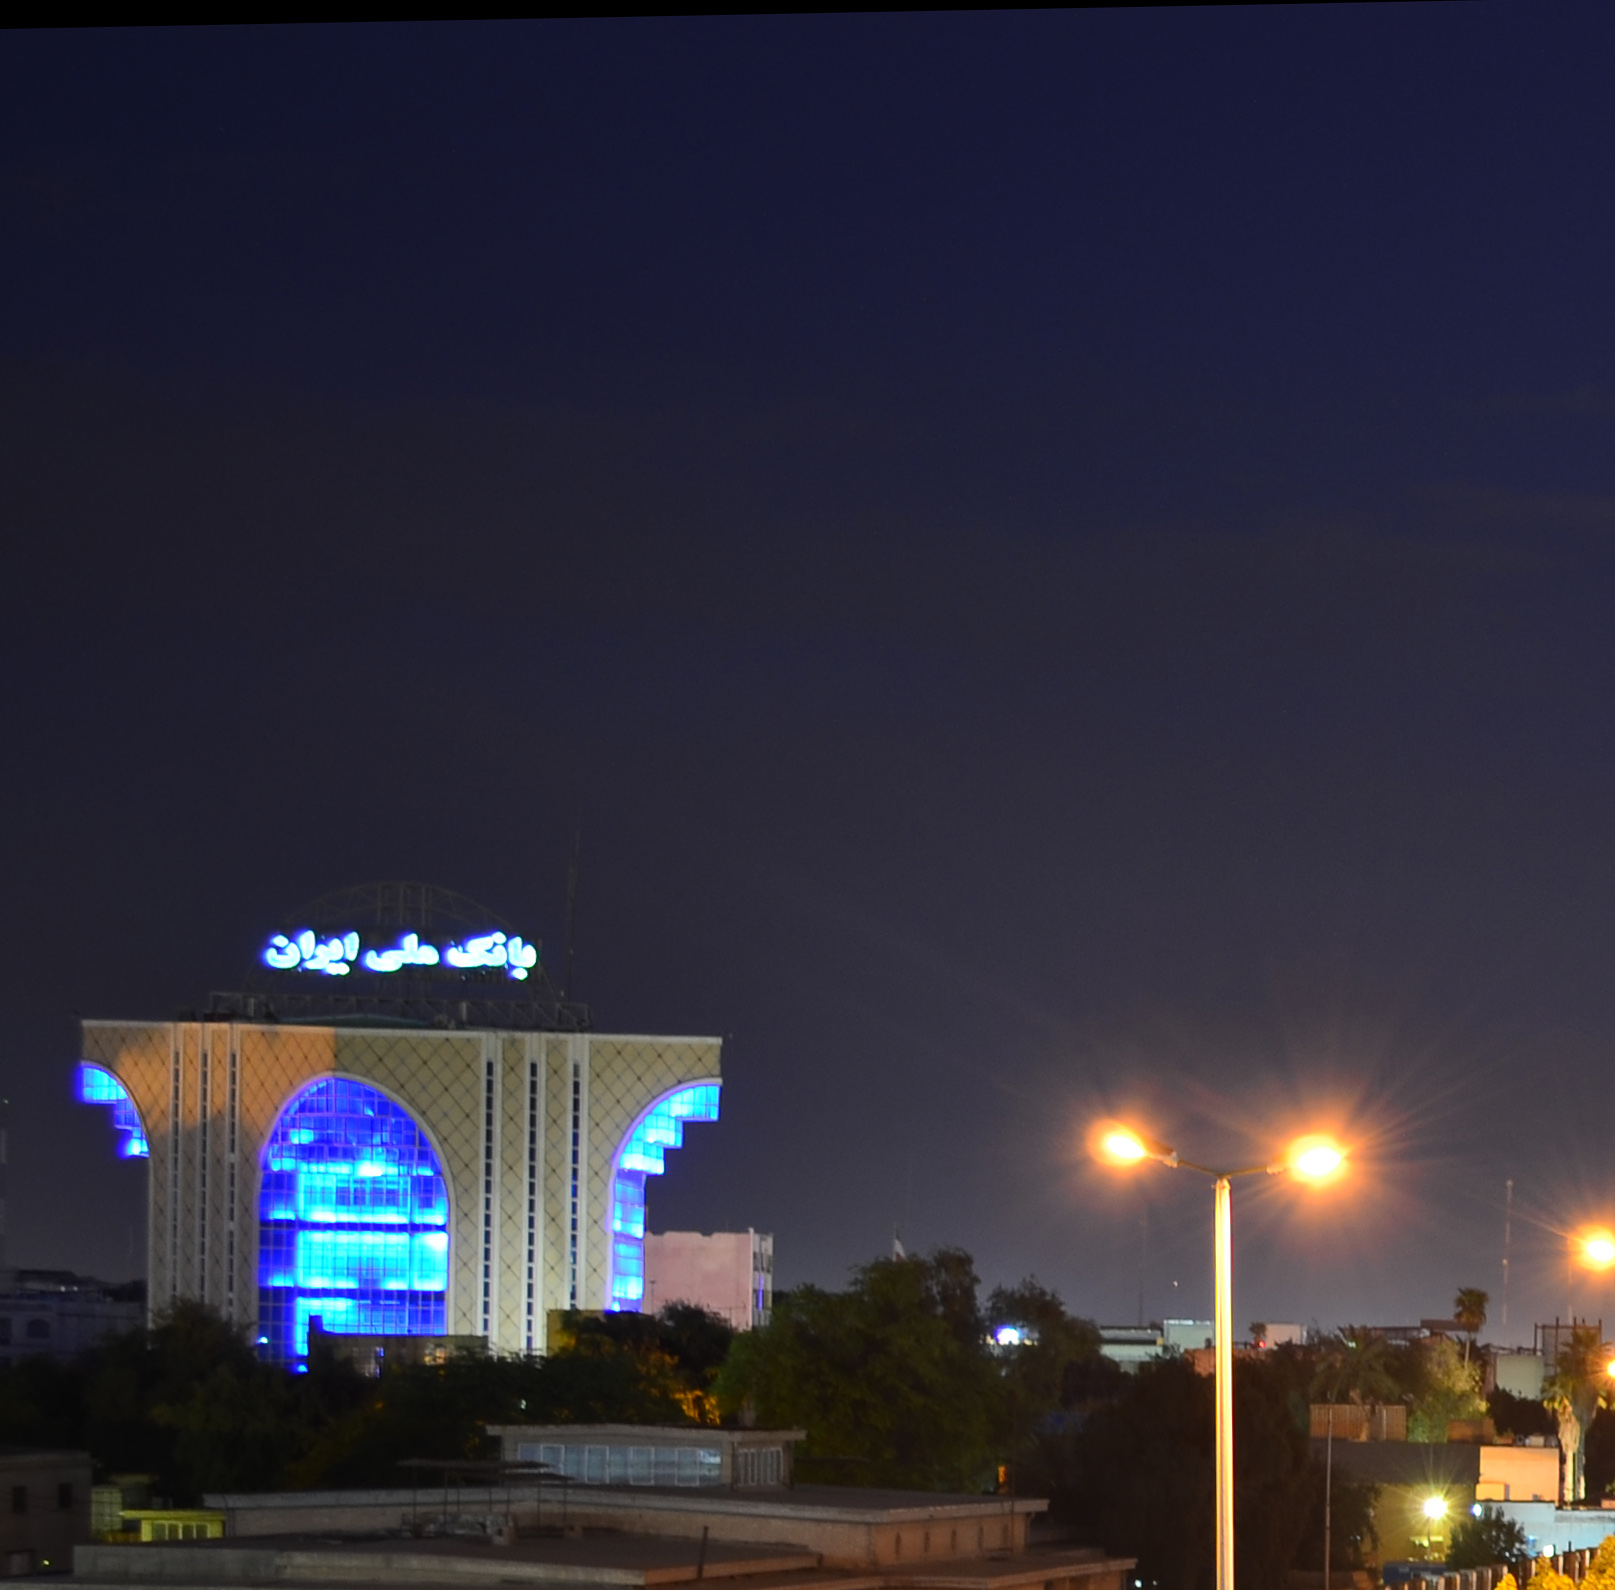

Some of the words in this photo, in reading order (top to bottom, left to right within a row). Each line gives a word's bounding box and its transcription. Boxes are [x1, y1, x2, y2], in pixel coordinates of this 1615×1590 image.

[265, 929, 360, 975] ایران
[365, 932, 440, 972] ملی
[446, 930, 537, 980] بانک
